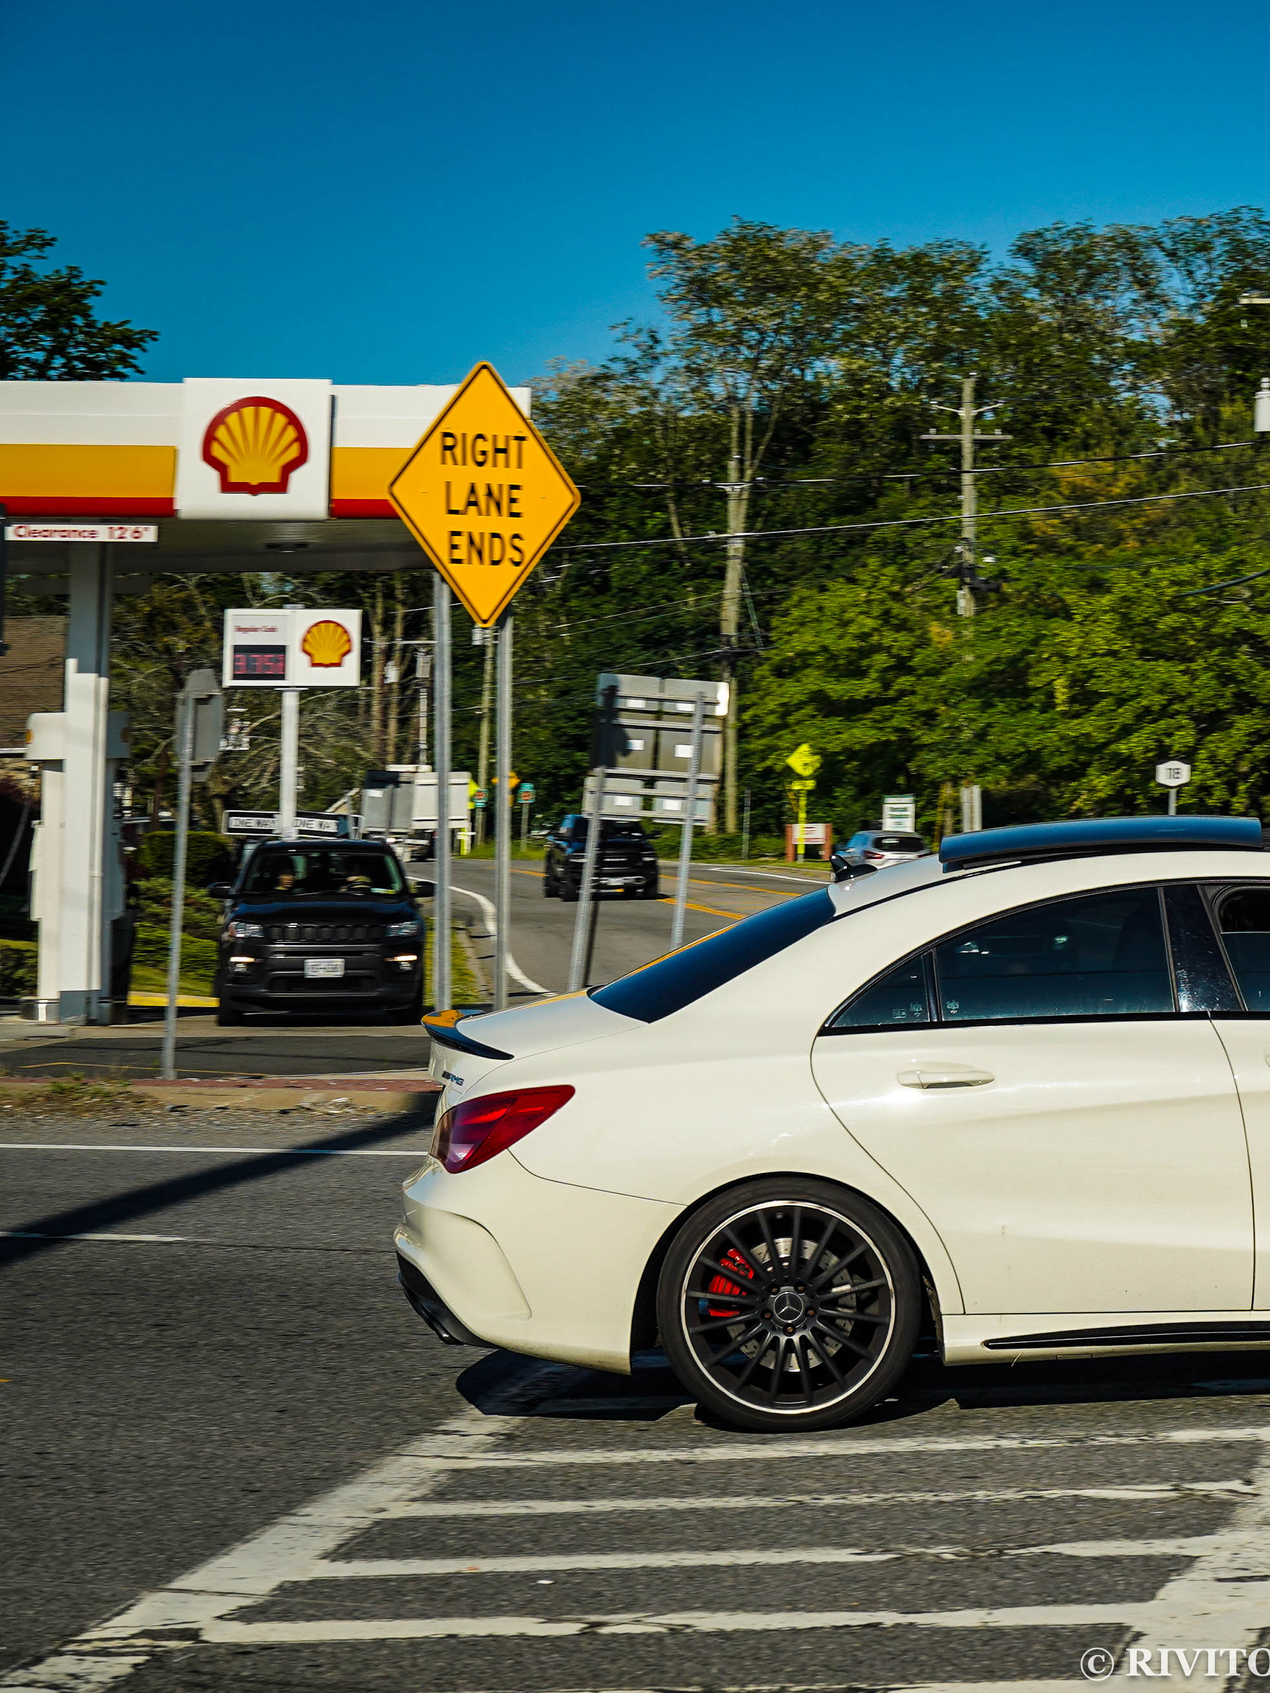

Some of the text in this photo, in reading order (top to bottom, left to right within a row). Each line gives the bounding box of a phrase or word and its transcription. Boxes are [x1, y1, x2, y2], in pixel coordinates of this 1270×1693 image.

[440, 431, 527, 469] RIGHT
[445, 480, 523, 518] LANE
[13, 524, 99, 539] Clearance
[447, 530, 525, 567] ENDS
